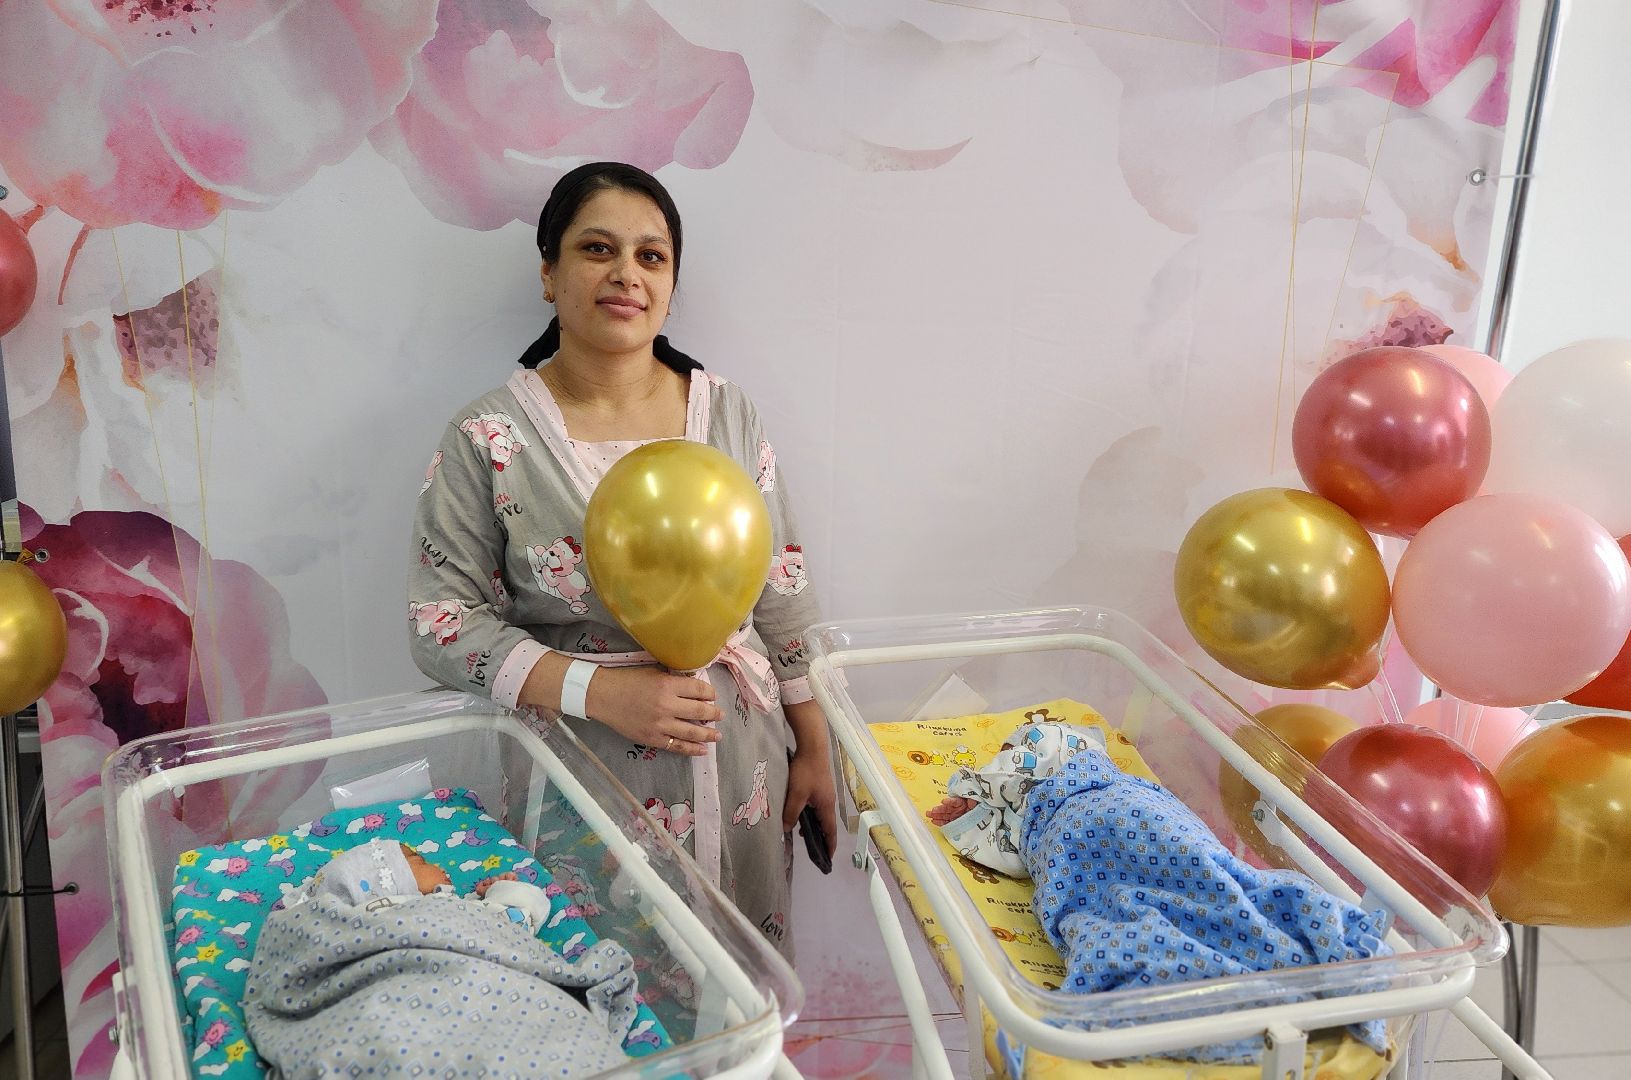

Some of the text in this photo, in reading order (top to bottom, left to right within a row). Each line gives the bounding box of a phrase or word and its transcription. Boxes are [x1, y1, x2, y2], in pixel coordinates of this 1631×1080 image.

[469, 650, 491, 687] love
[627, 743, 647, 759] ve
[986, 897, 1033, 908] Rilakku
[760, 912, 784, 941] love
